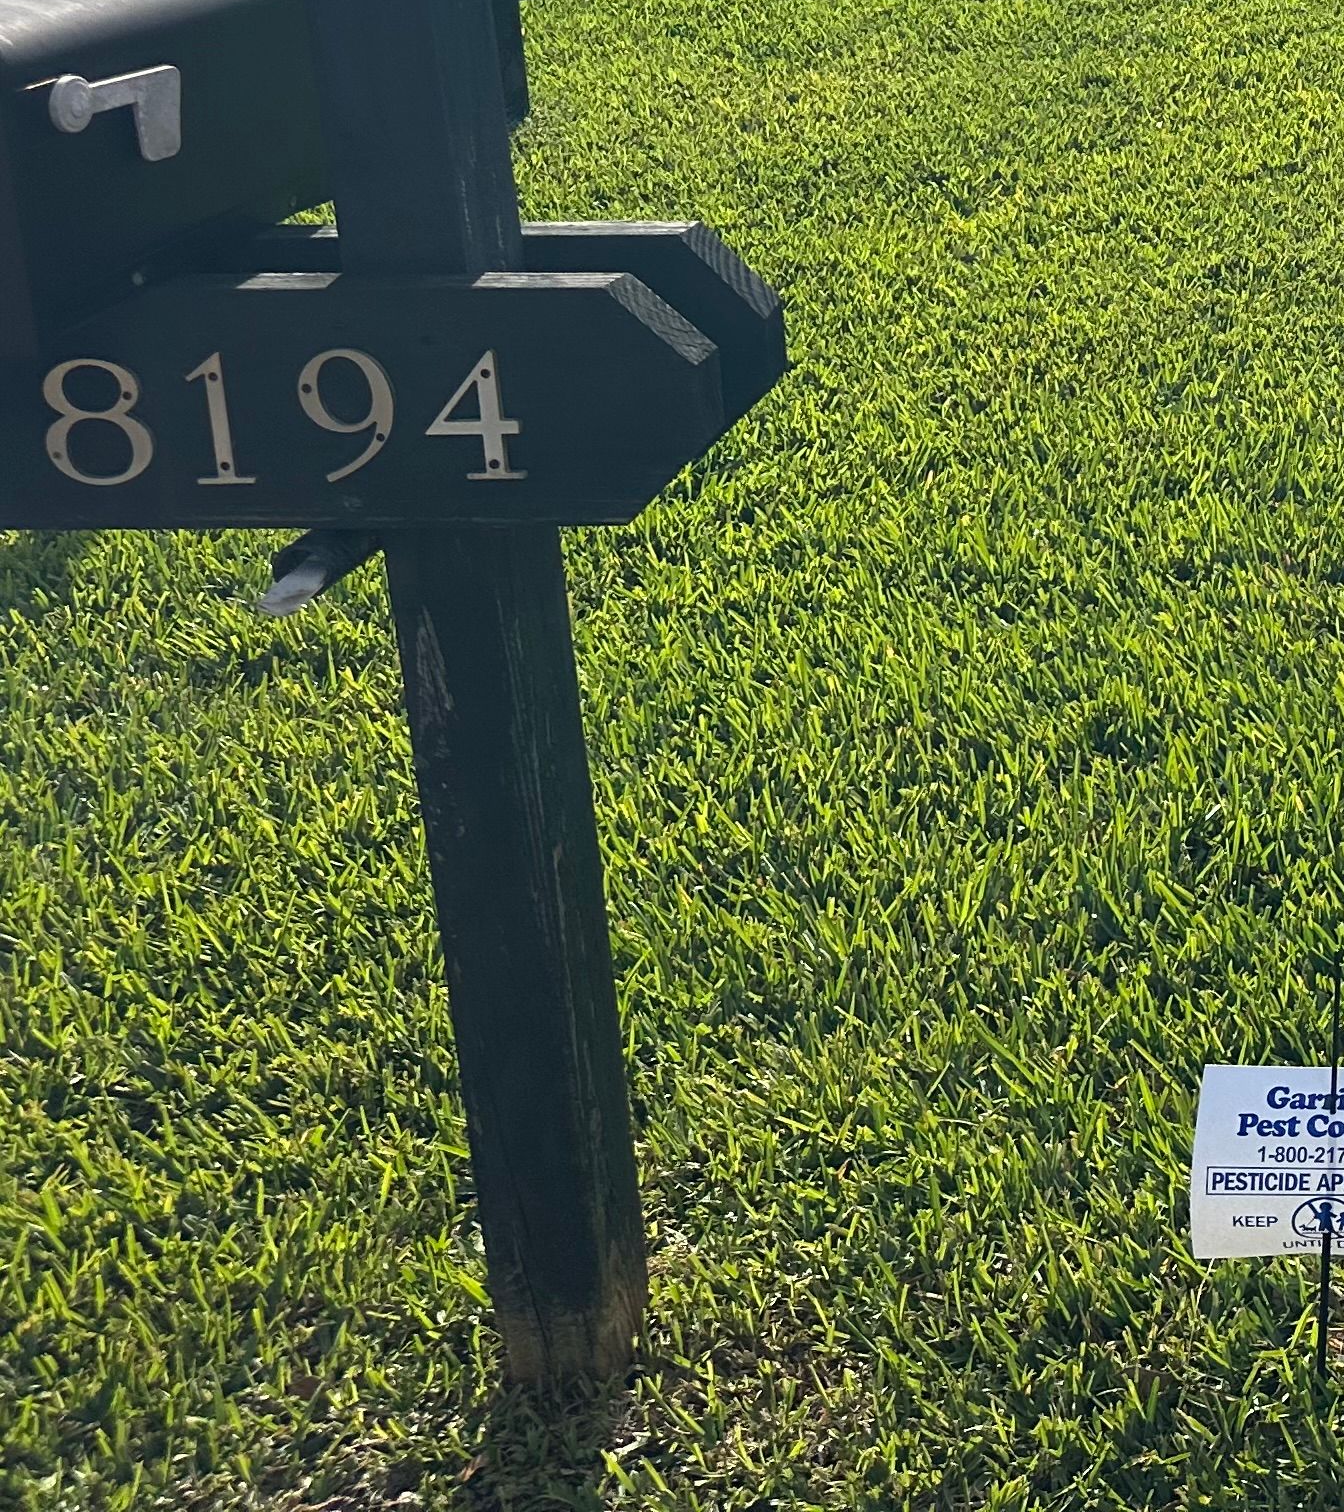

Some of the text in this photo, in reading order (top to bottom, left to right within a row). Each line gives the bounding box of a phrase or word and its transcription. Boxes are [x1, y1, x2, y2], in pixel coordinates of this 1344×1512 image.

[42, 348, 528, 486] 8194
[1236, 1113, 1301, 1137] Pest
[1211, 1172, 1311, 1191] PESTICIDE
[1232, 1215, 1279, 1228] KEEP
[1282, 1240, 1331, 1249] UNTI
